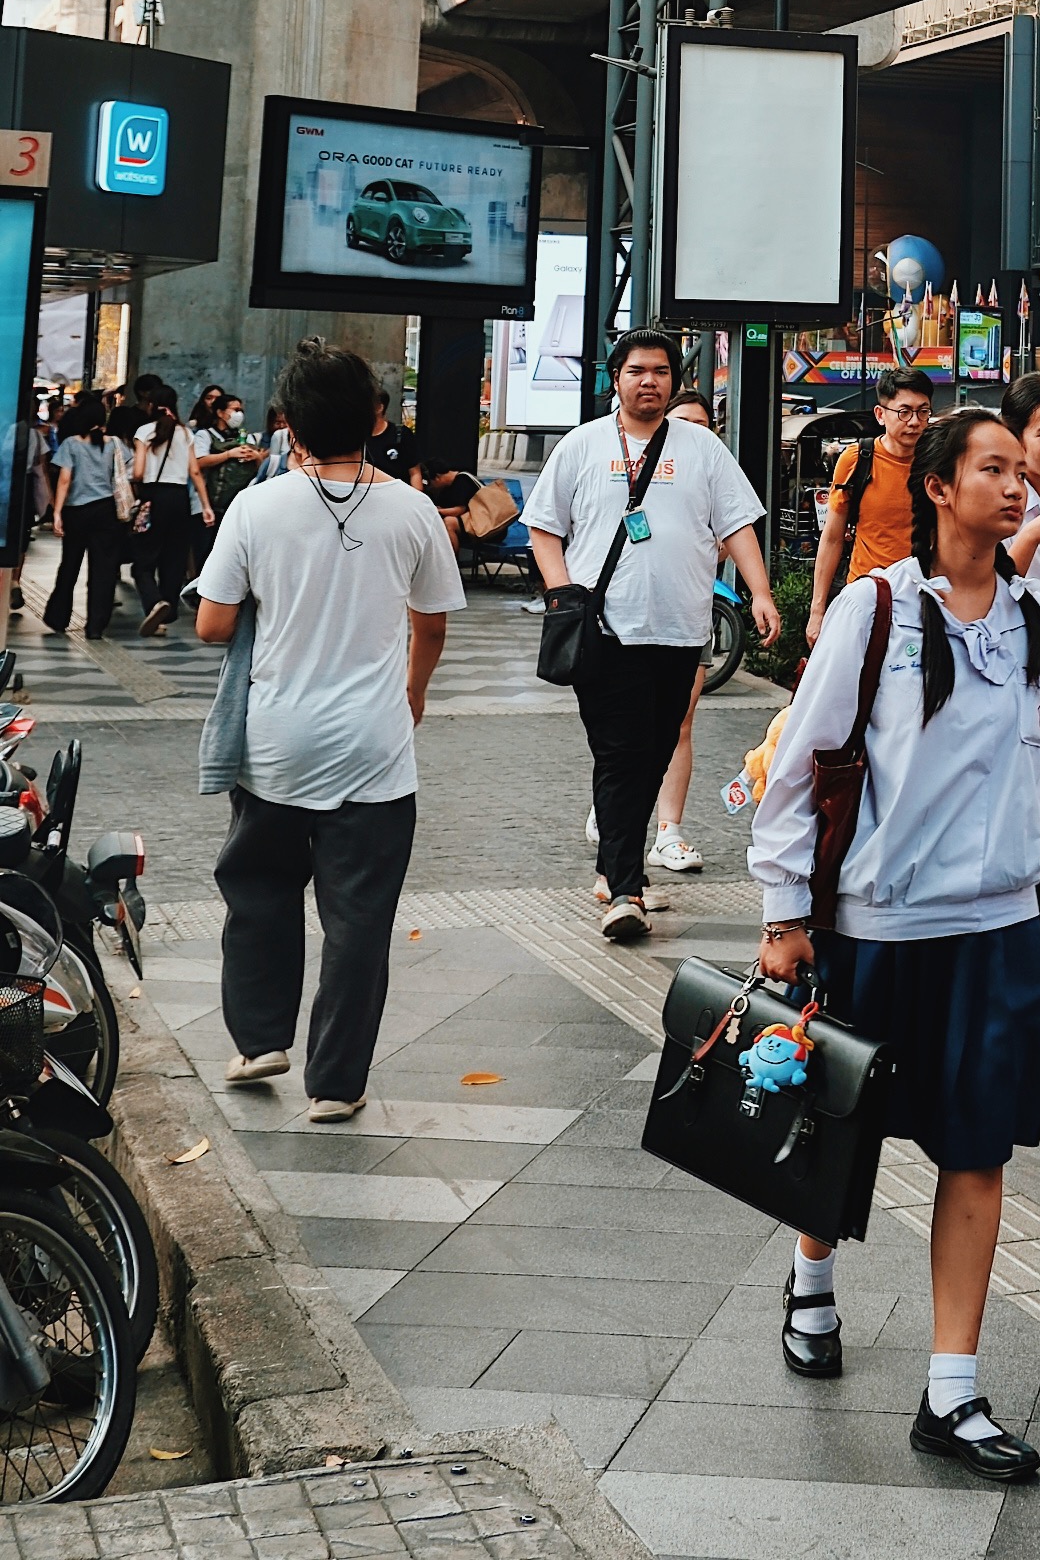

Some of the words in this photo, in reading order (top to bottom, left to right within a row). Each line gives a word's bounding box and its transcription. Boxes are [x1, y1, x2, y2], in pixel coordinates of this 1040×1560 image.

[296, 127, 324, 136] GWM
[9, 137, 39, 176] 3
[318, 151, 359, 164] ORA
[362, 154, 393, 167] GOOD
[395, 158, 414, 169] CAT
[419, 161, 462, 173] FUTURE
[467, 166, 503, 177] READY
[114, 171, 157, 184] watsons
[554, 265, 582, 274] Galaxy
[841, 371, 855, 380] OF
